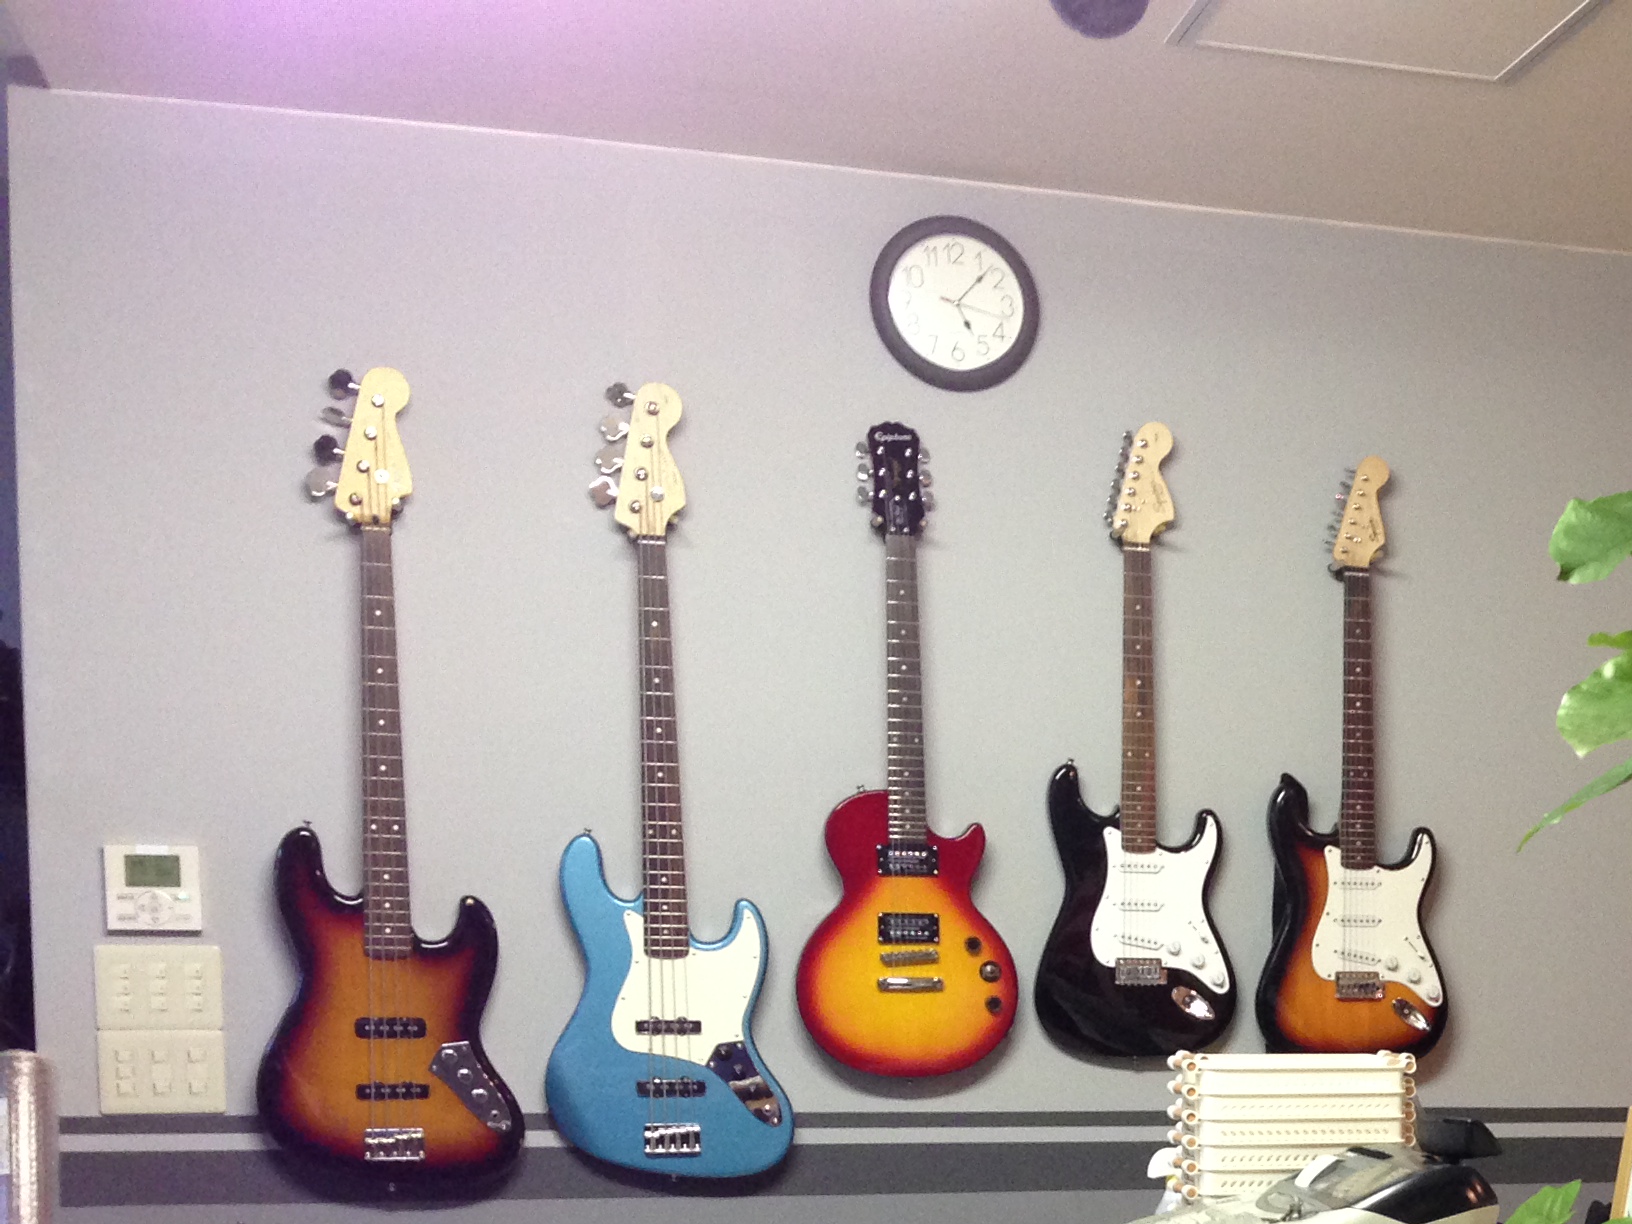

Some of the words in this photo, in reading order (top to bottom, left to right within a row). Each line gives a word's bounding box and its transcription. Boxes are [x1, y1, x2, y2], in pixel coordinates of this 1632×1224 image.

[924, 246, 939, 267] 11
[943, 242, 965, 265] 12
[975, 251, 983, 271] 1
[903, 265, 925, 288] 10
[991, 268, 1006, 290] 2
[1000, 295, 1015, 318] 3
[992, 322, 1005, 342] 4
[928, 335, 939, 355] 7
[951, 341, 966, 362] 6
[977, 335, 990, 356] 5
